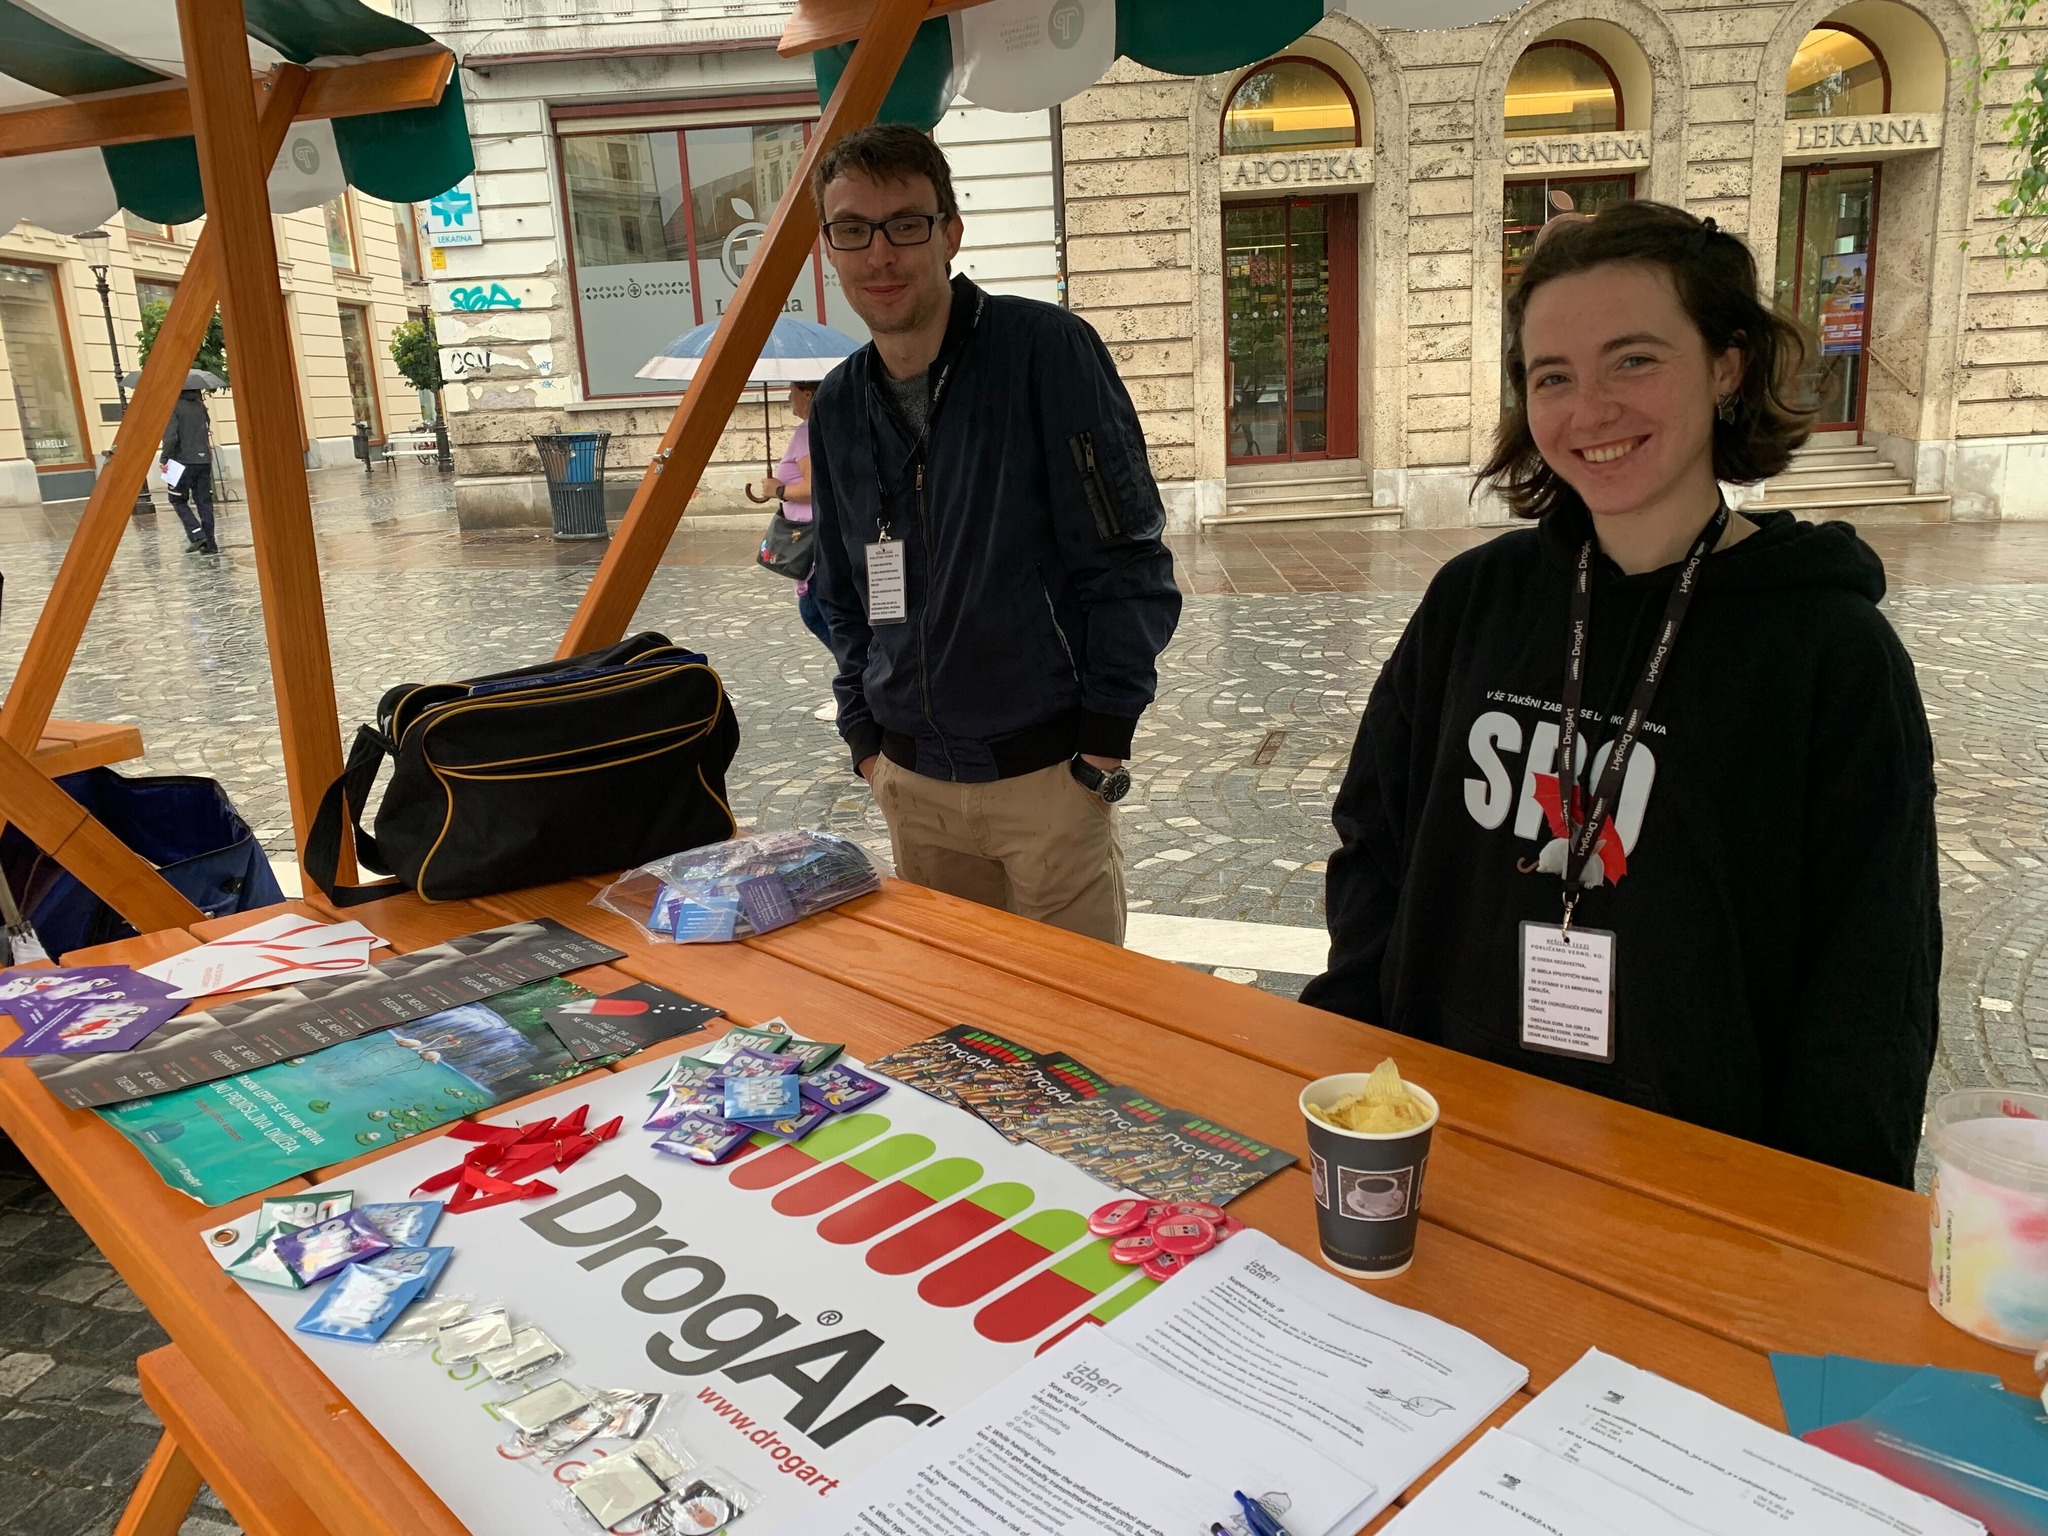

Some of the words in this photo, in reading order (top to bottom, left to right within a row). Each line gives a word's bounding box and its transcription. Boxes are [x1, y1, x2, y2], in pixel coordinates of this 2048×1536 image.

[1797, 119, 1929, 150] LEKARNA
[1505, 139, 1649, 168] CENTRALNA
[1233, 156, 1362, 186] APOTEKA
[35, 439, 69, 450] MARELLA
[1679, 557, 1700, 594] DrogArt
[1571, 620, 1584, 656] DrogArt
[1646, 646, 1667, 683] DrogArt
[1506, 693, 1542, 708] TAKŠNI
[1541, 701, 1562, 713] ZAB
[1580, 708, 1594, 719] SE
[1642, 721, 1667, 735] RIVA
[1563, 708, 1575, 745] DrogArt
[1611, 733, 1633, 771] DrogArt
[1578, 821, 1598, 857] DrogArt
[209, 1082, 233, 1095] LNO
[222, 1091, 274, 1131] PRENOSLJIVA
[253, 1089, 280, 1105] LEPOTI
[271, 1102, 288, 1112] SE
[279, 1110, 305, 1129] LAHKO
[297, 1126, 325, 1146] SKRIVA
[1160, 1131, 1244, 1172] DrogArt
[1243, 1266, 1268, 1283] sam
[1228, 1276, 1262, 1299] Supersexy
[1261, 1297, 1276, 1308] kviz
[519, 1173, 945, 1450] DrogAr
[1048, 1382, 1065, 1394] Sexy
[1064, 1393, 1080, 1402] quiz
[1062, 1371, 1098, 1394] sam
[1031, 1394, 1063, 1413] infection?
[1021, 1420, 1035, 1428] HIV
[1030, 1414, 1061, 1436] Chlamydia
[1038, 1409, 1070, 1430] Gonorrhea
[1013, 1426, 1037, 1441] Genital
[1034, 1439, 1056, 1456] herpes
[1047, 1392, 1064, 1405] What
[1069, 1406, 1080, 1414] the
[1080, 1413, 1097, 1426] most
[1096, 1424, 1125, 1443] common
[1124, 1442, 1151, 1458] sexually
[1151, 1456, 1192, 1479] transmitted
[918, 1471, 939, 1486] drink?
[976, 1430, 989, 1440] less
[986, 1438, 1006, 1451] likely
[1011, 1455, 1024, 1464] get
[1023, 1463, 1049, 1482] sexually
[1048, 1480, 1088, 1505] transmitted
[1086, 1502, 1116, 1522] infection
[977, 1454, 990, 1463] feel
[987, 1462, 1003, 1474] more
[1002, 1472, 1031, 1493] connected
[1030, 1492, 1043, 1501] with
[1042, 1500, 1053, 1508] my
[1051, 1506, 1074, 1520] partner
[985, 1424, 993, 1432] 2.
[992, 1429, 1010, 1442] While
[1009, 1440, 1031, 1458] having
[1030, 1456, 1042, 1465] sex
[1041, 1464, 1062, 1477] under
[1061, 1476, 1073, 1485] the
[1072, 1483, 1103, 1502] influence
[1110, 1506, 1138, 1521] alcohol
[1136, 1520, 1152, 1530] and
[992, 1453, 1007, 1464] more
[1007, 1463, 1028, 1478] relaxed
[1026, 1476, 1053, 1495] therefore
[1061, 1499, 1074, 1508] less
[1073, 1507, 1097, 1522] chances
[925, 1487, 935, 1497] You
[934, 1496, 949, 1507] drink
[948, 1506, 961, 1516] only
[960, 1515, 977, 1528] water
[933, 1469, 949, 1481] How
[947, 1480, 960, 1490] can
[958, 1488, 972, 1499] you
[970, 1497, 997, 1517] prevent
[996, 1514, 1008, 1524] the
[1007, 1523, 1020, 1532] risk
[974, 1465, 990, 1477] more
[988, 1476, 1022, 1500] circumspect
[1020, 1498, 1034, 1507] and
[1031, 1505, 1066, 1527] determined
[1478, 1490, 1494, 1500] SPO
[1500, 1500, 1520, 1513] SEXY
[869, 1504, 876, 1512] 4.
[875, 1510, 893, 1525] What
[891, 1523, 906, 1535] type
